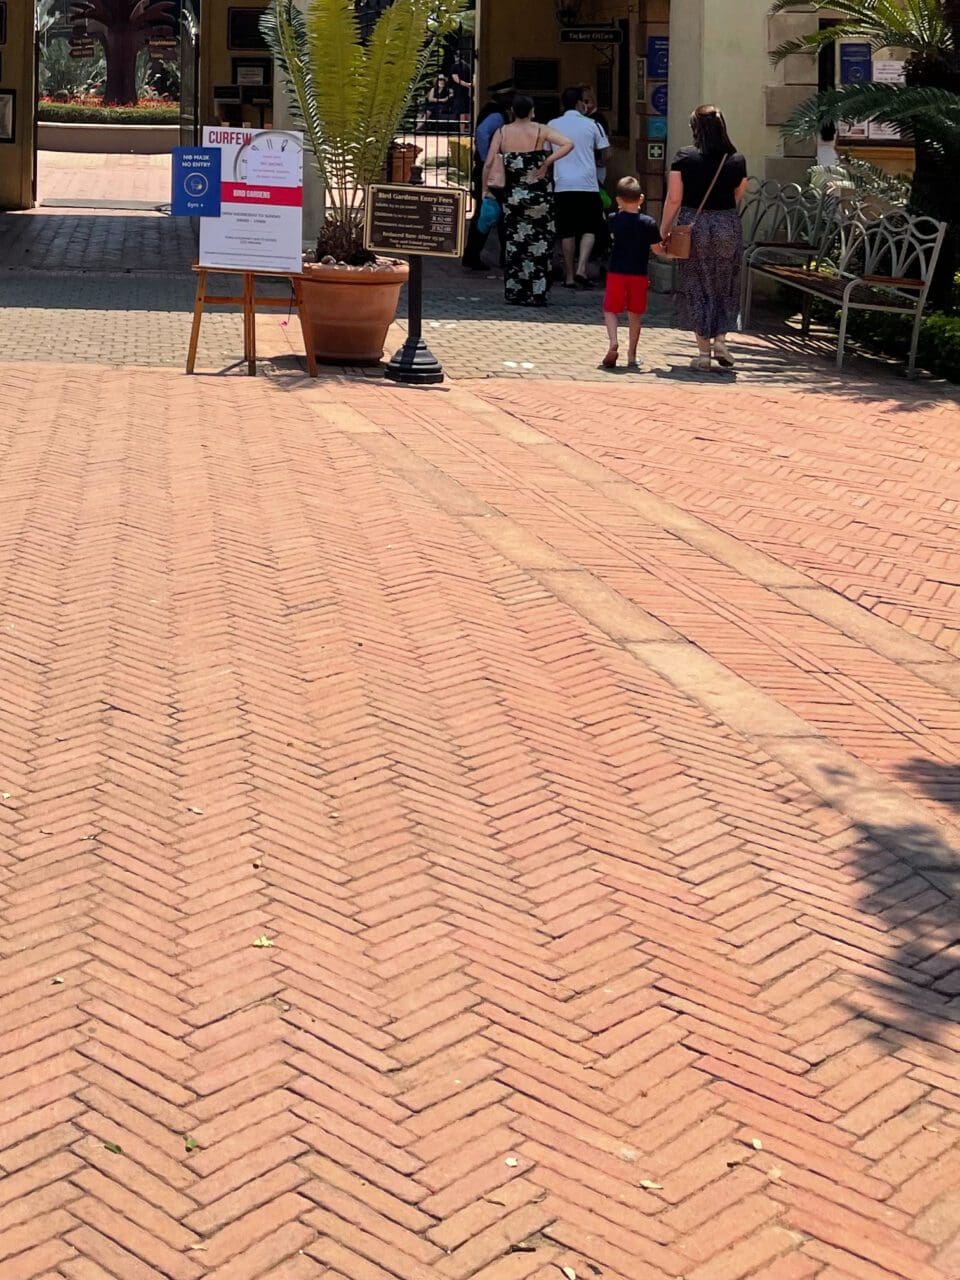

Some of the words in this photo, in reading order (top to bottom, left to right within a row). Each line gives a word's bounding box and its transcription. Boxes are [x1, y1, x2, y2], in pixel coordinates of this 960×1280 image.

[208, 130, 253, 145] CURFEW
[378, 192, 392, 200] Bird
[392, 193, 419, 201] Gardens
[420, 195, 438, 204] Entry
[438, 196, 453, 204] Fees
